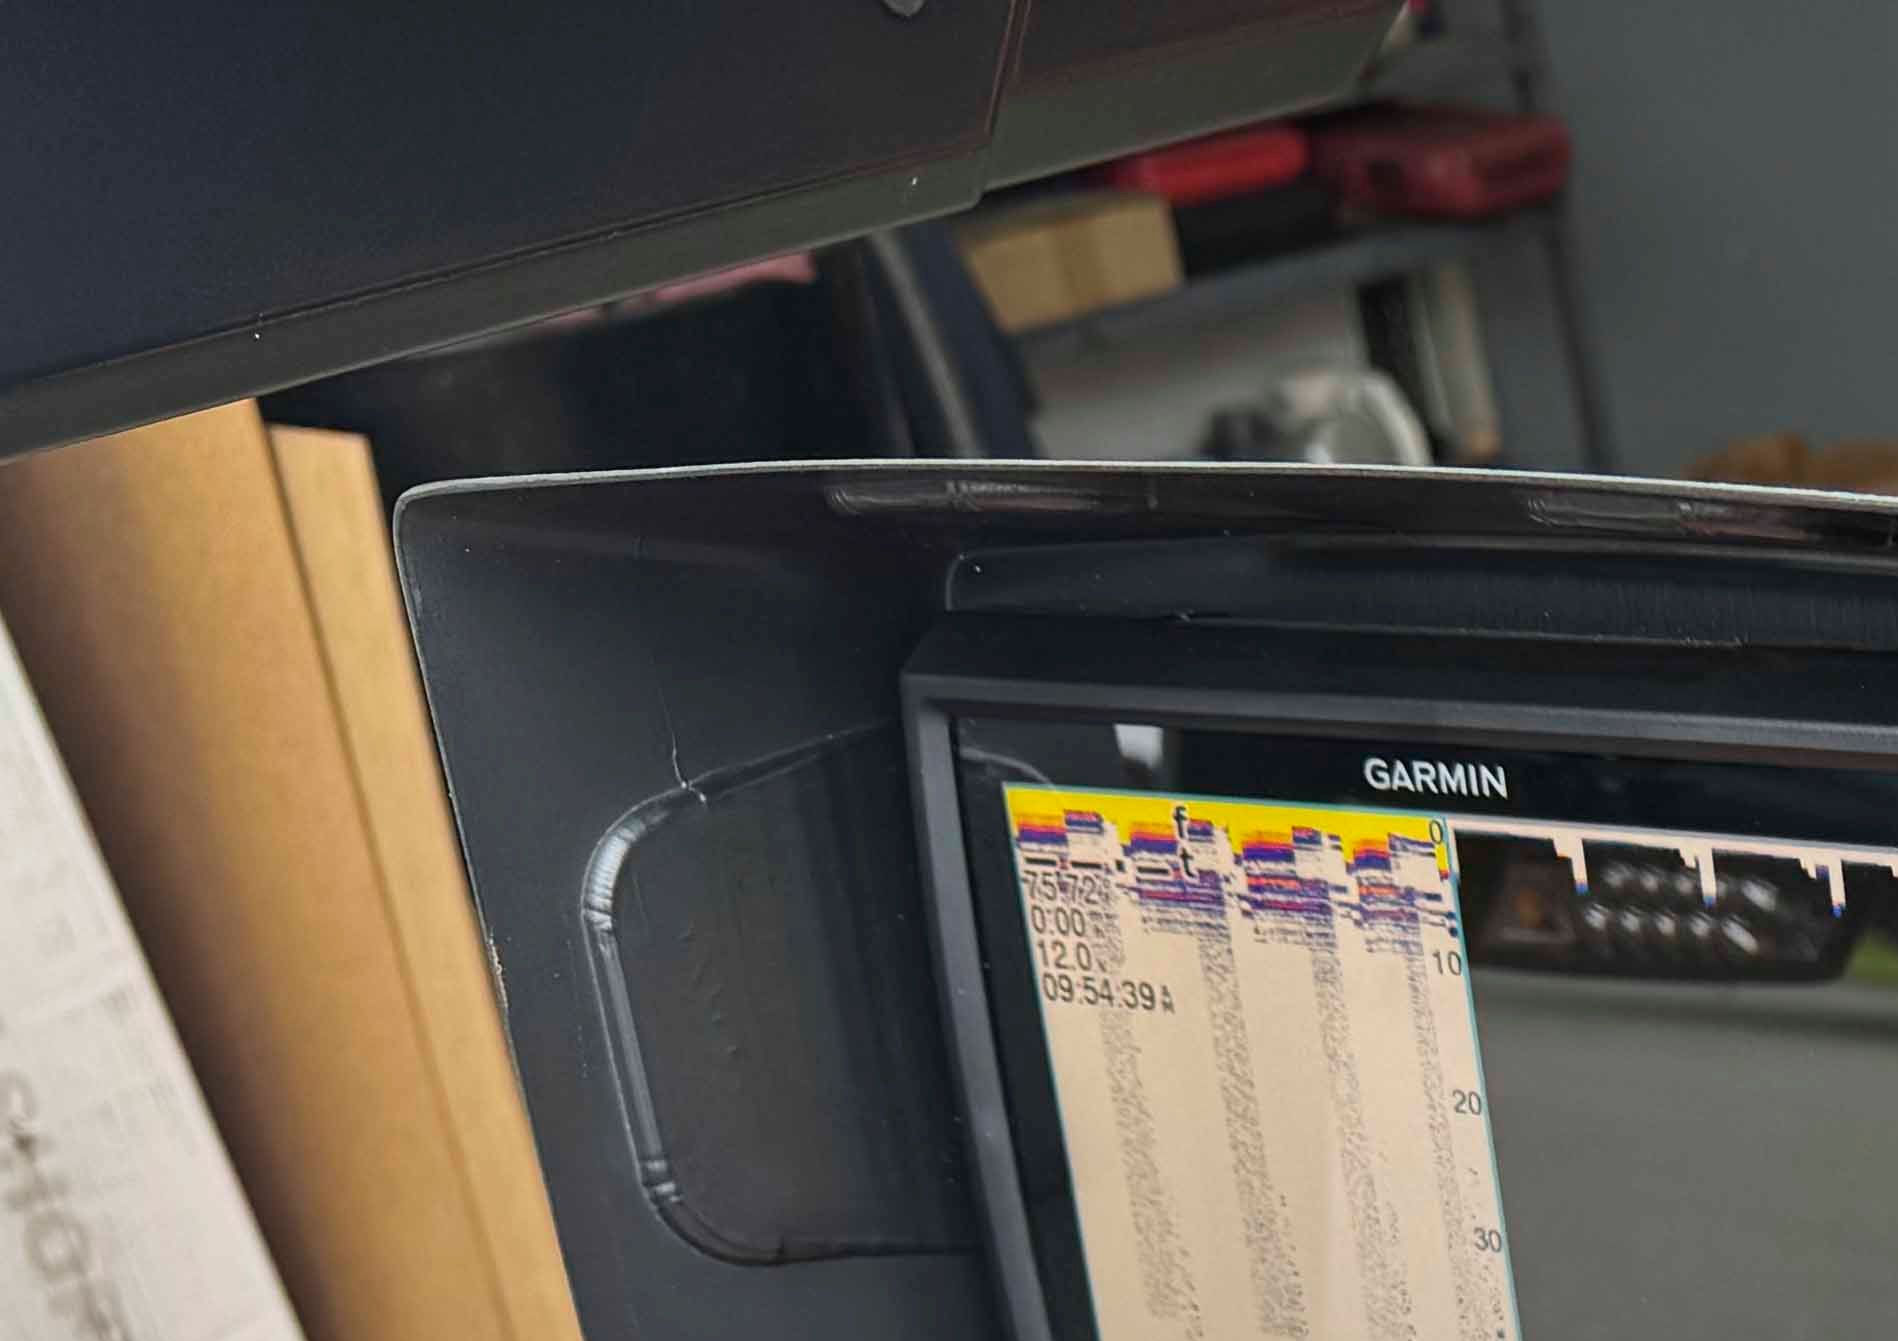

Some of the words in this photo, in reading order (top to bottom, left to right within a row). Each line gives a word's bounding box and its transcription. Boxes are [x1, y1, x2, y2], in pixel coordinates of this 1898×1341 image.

[1364, 757, 1508, 799] GARMIN
[1433, 951, 1462, 977] 10
[1452, 1090, 1481, 1115] 20
[1473, 1229, 1502, 1253] 30
